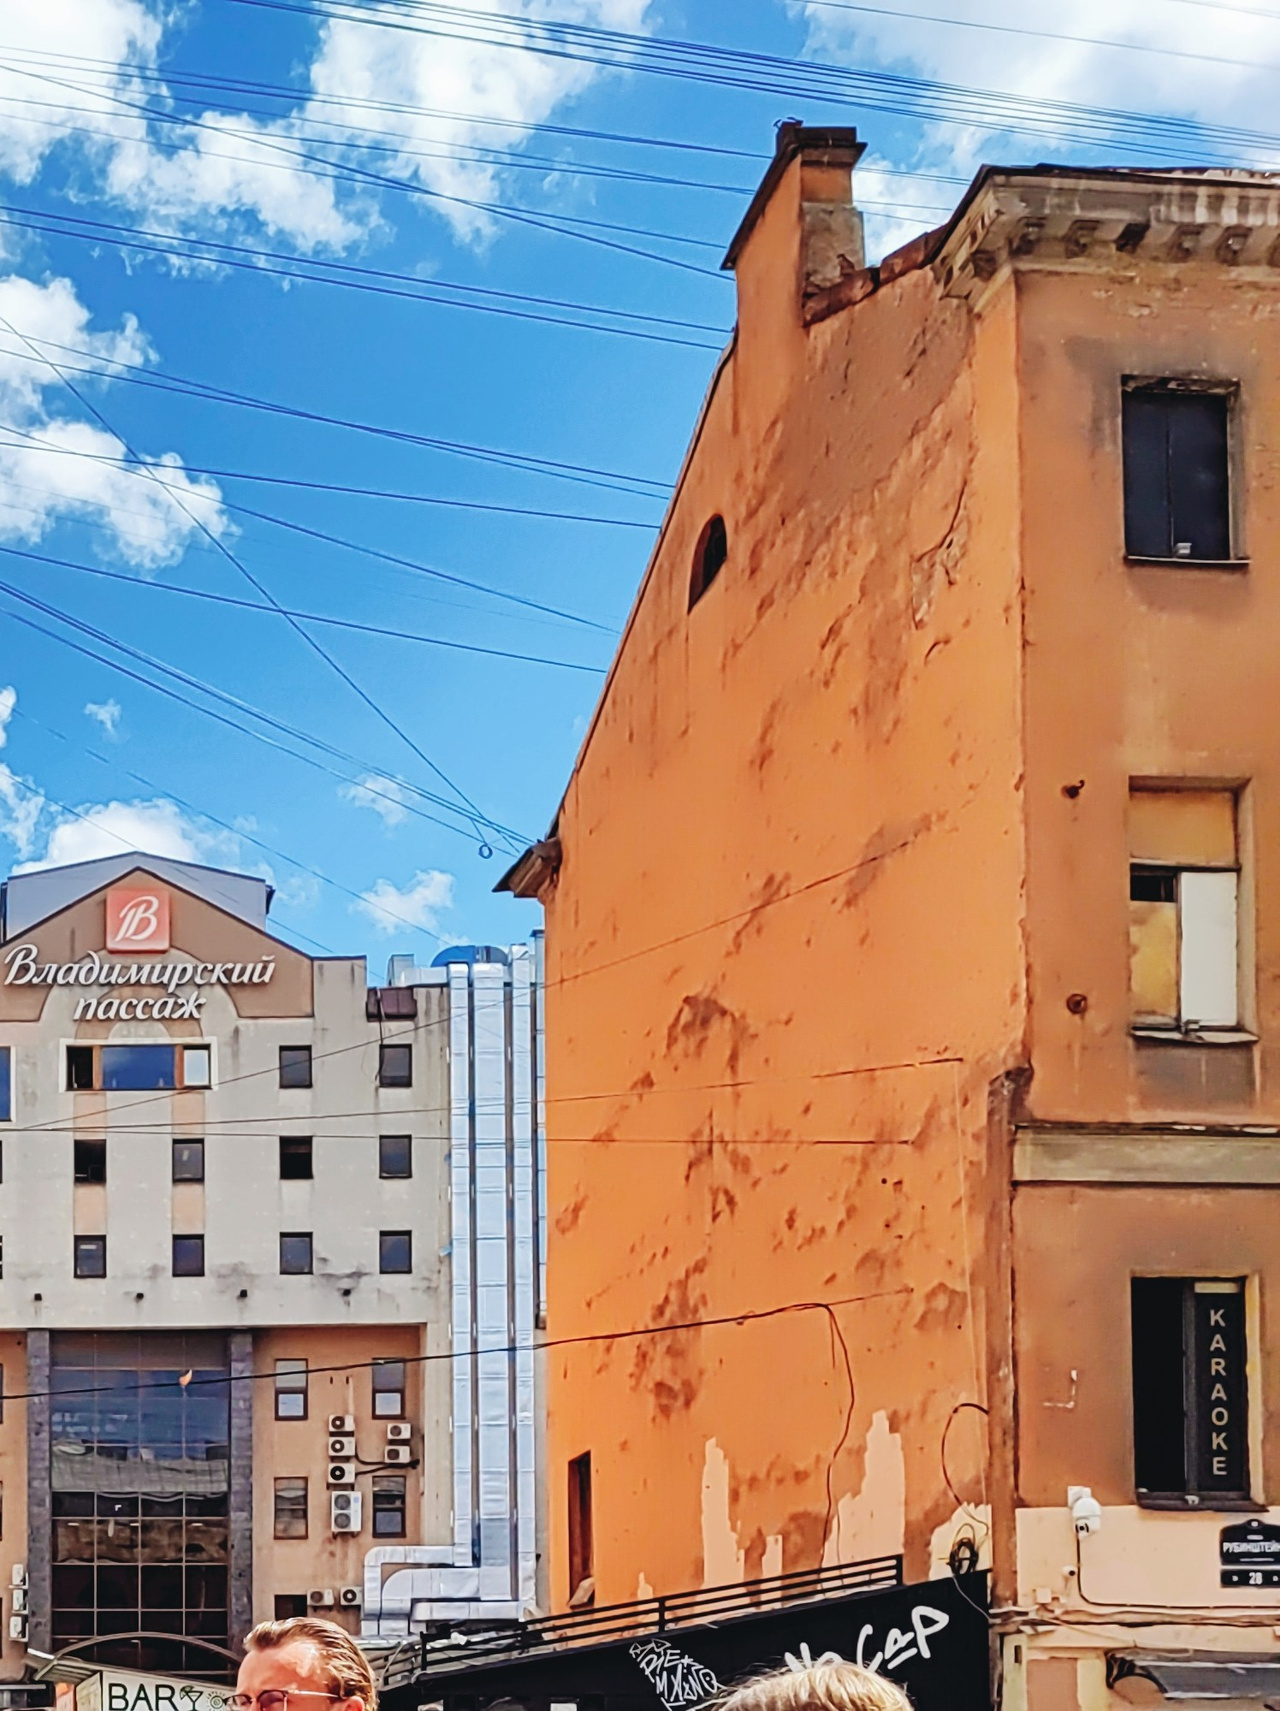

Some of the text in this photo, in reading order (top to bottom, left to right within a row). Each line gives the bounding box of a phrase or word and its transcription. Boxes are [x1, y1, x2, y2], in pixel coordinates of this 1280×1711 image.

[4, 943, 276, 993] Владимирский
[73, 990, 207, 1021] пассаж
[1209, 1308, 1229, 1476] KARAOKE
